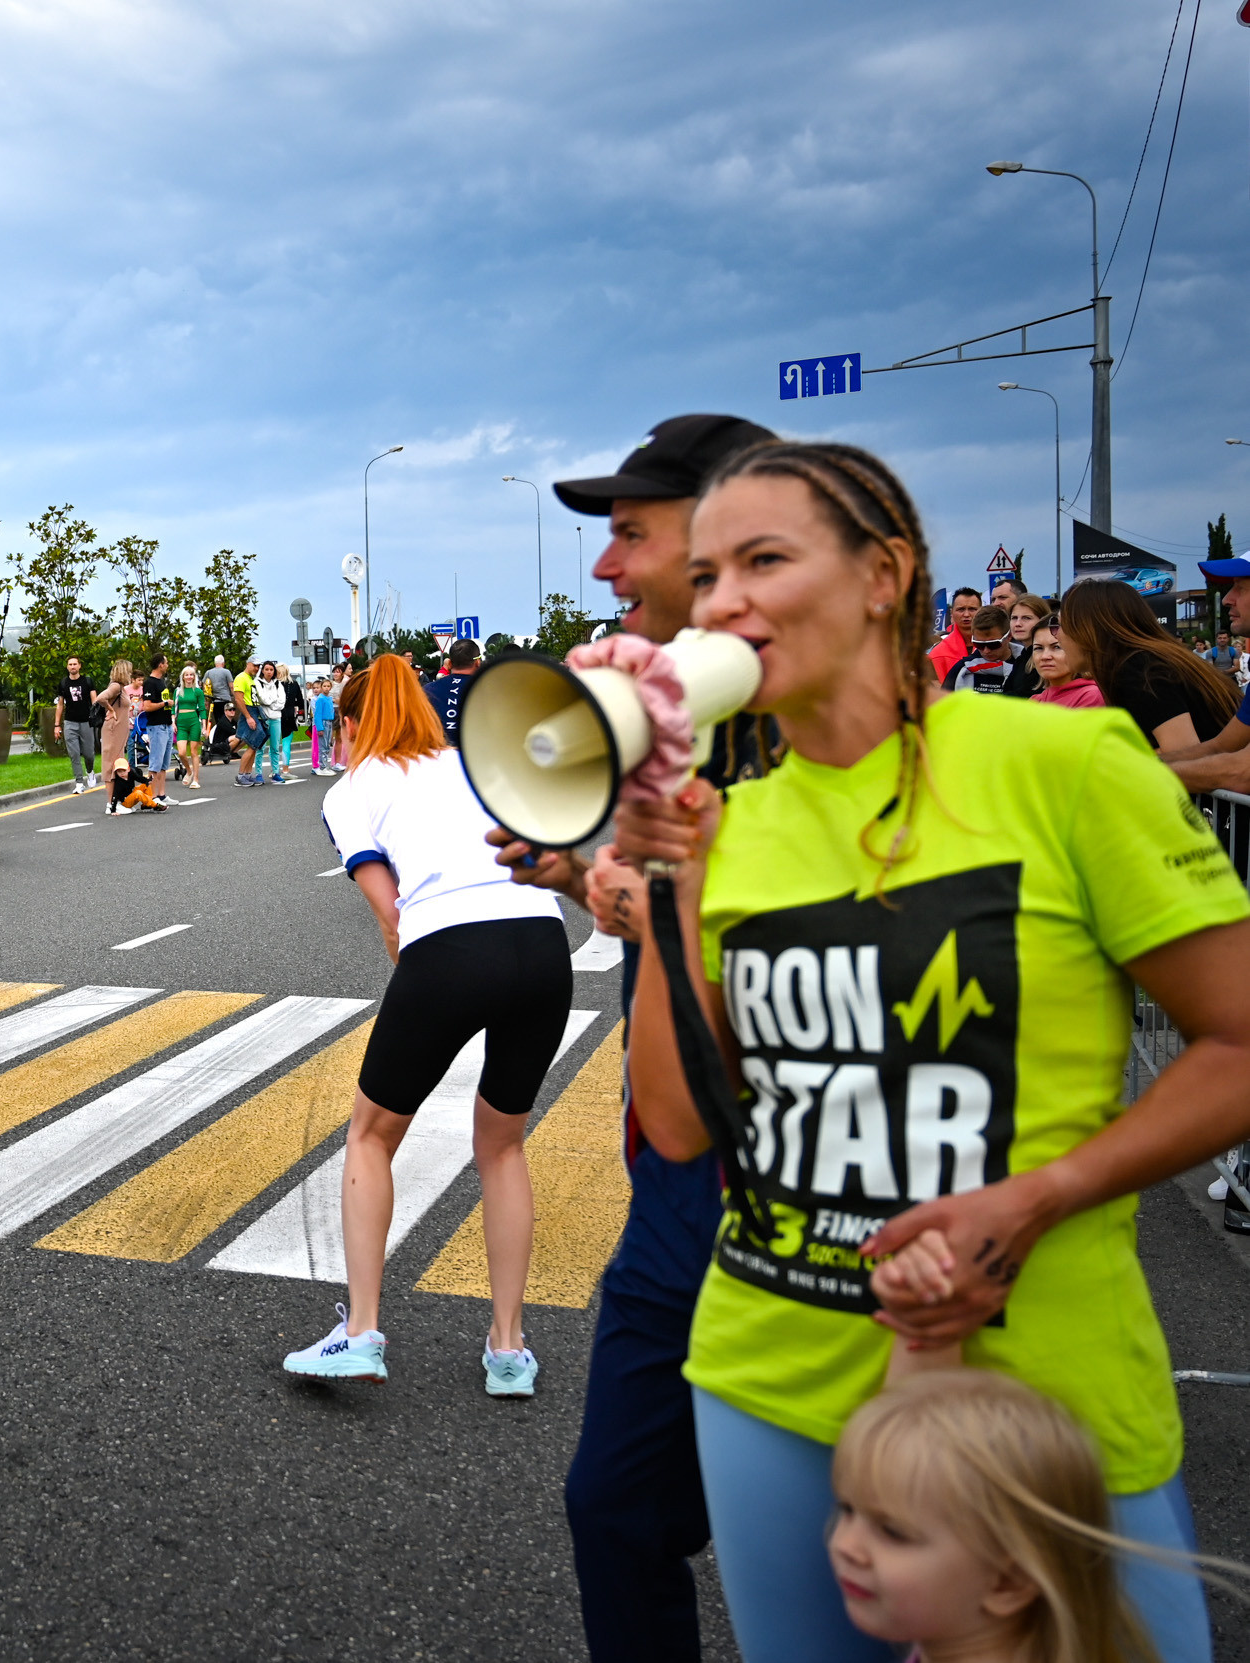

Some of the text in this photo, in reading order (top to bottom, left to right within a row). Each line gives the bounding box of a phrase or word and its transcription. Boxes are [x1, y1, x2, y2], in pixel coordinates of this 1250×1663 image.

[446, 677, 462, 730] RYZON
[723, 944, 884, 1054] IRON
[737, 1056, 993, 1201] STAR
[813, 1208, 887, 1245] FINIS
[320, 1339, 349, 1357] HOKA
